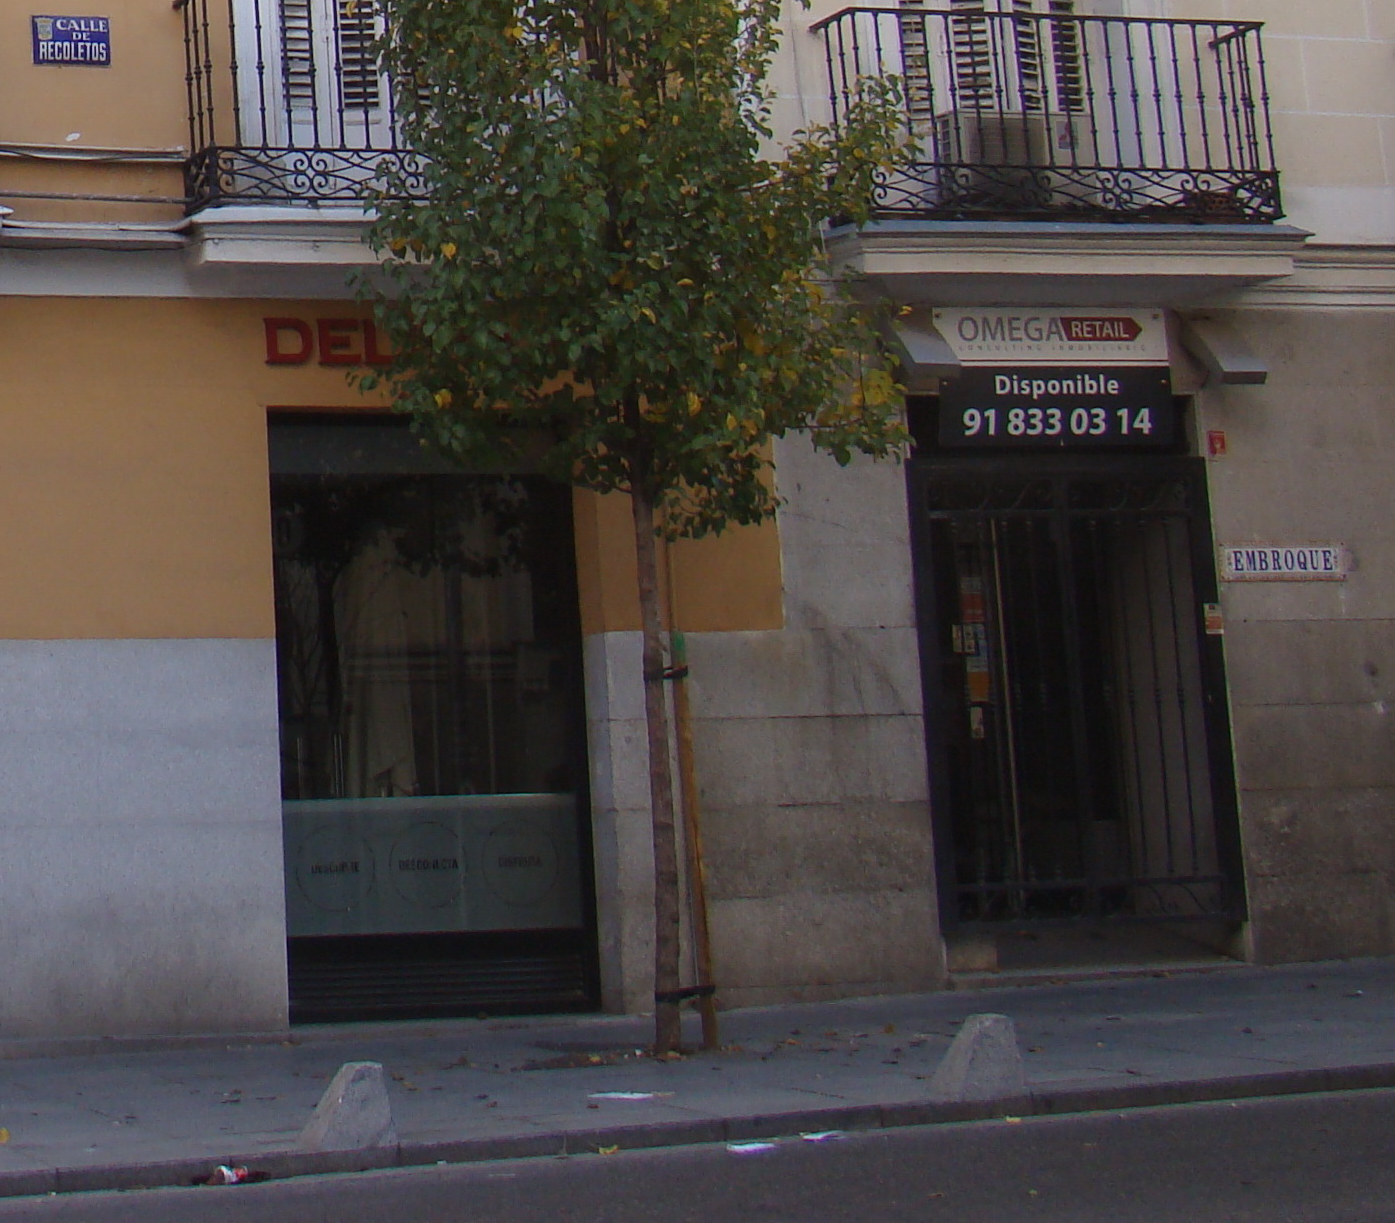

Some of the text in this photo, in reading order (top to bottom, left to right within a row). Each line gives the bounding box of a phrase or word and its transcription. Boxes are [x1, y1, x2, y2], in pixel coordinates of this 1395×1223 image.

[56, 19, 108, 33] CALLE
[72, 31, 91, 41] DE
[39, 41, 107, 62] RECOLETOS
[957, 316, 1130, 342] OMEGA RETAIL
[995, 374, 1119, 399] Disponible
[962, 407, 1152, 436] 91 833 03 14
[1232, 549, 1333, 572] EMBROQUE
